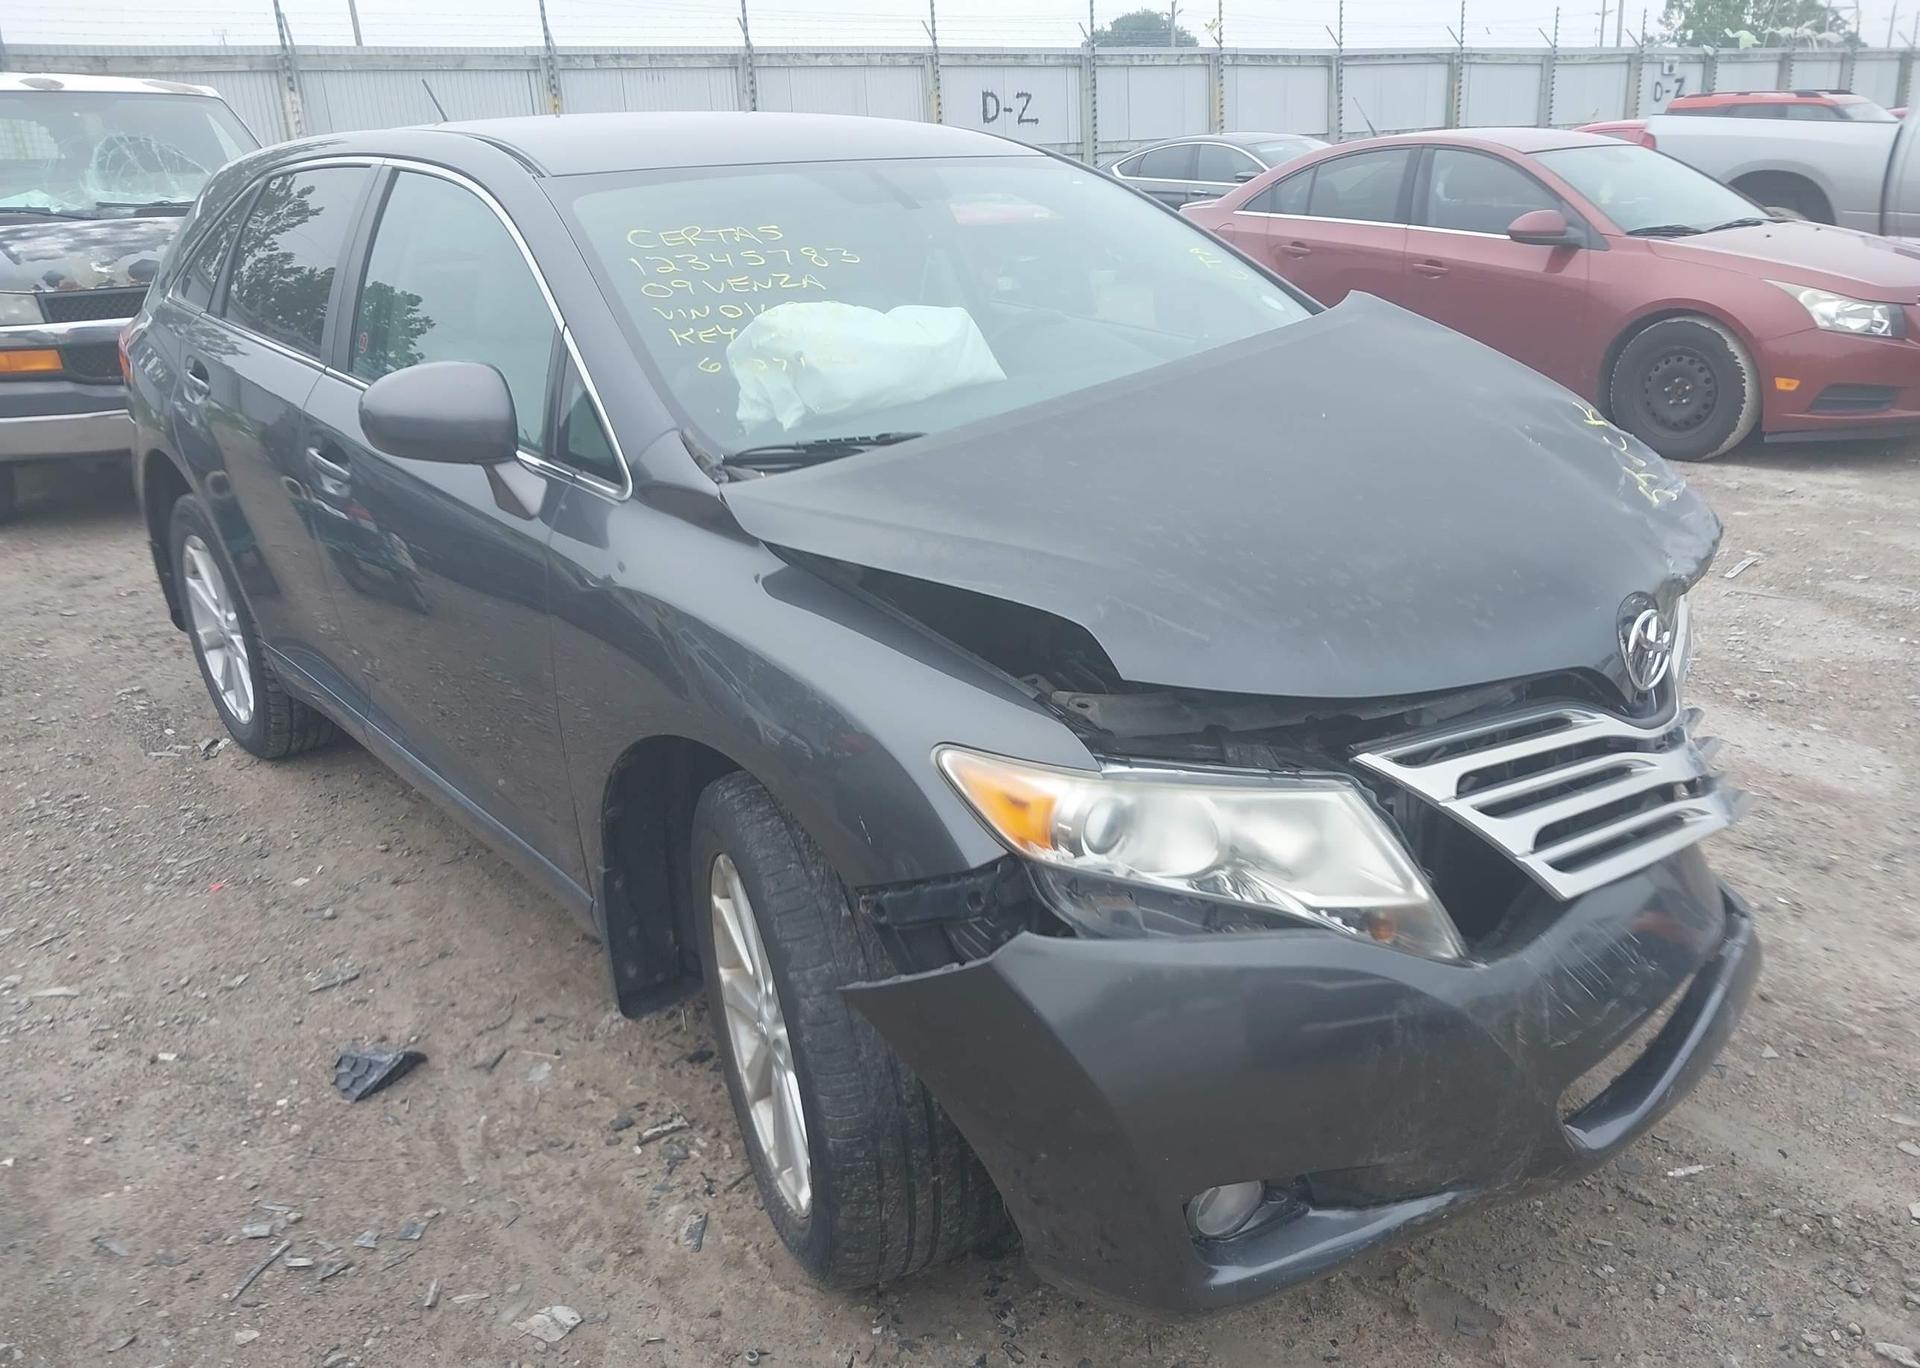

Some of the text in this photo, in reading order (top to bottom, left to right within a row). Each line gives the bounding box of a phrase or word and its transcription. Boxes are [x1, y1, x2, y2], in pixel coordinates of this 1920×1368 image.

[628, 246, 861, 276] 12345783
[702, 273, 827, 294] VENZA
[652, 304, 711, 320] VIN
[668, 324, 738, 347] KEY
